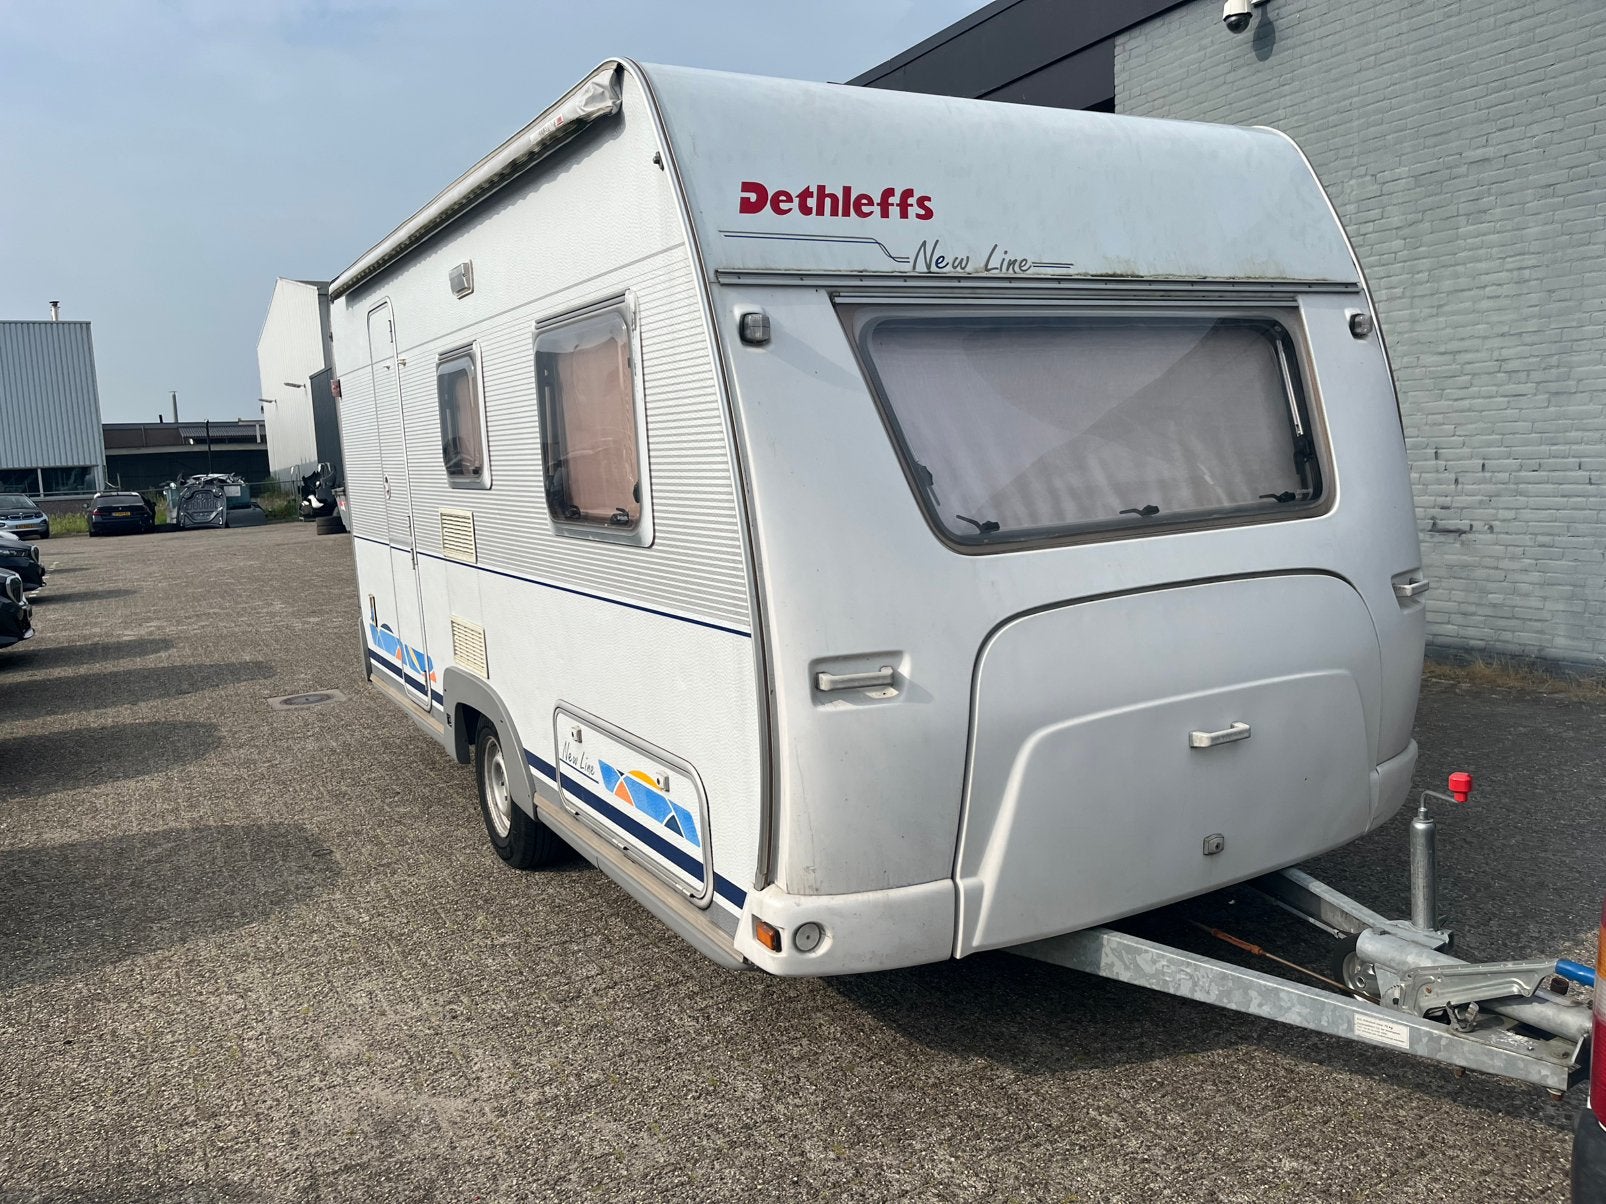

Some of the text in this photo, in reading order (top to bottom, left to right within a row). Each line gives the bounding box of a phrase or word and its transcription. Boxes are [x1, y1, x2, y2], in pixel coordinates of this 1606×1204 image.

[739, 181, 934, 220] Dethleffs
[912, 239, 1032, 273] New Line
[562, 741, 595, 775] New Line
